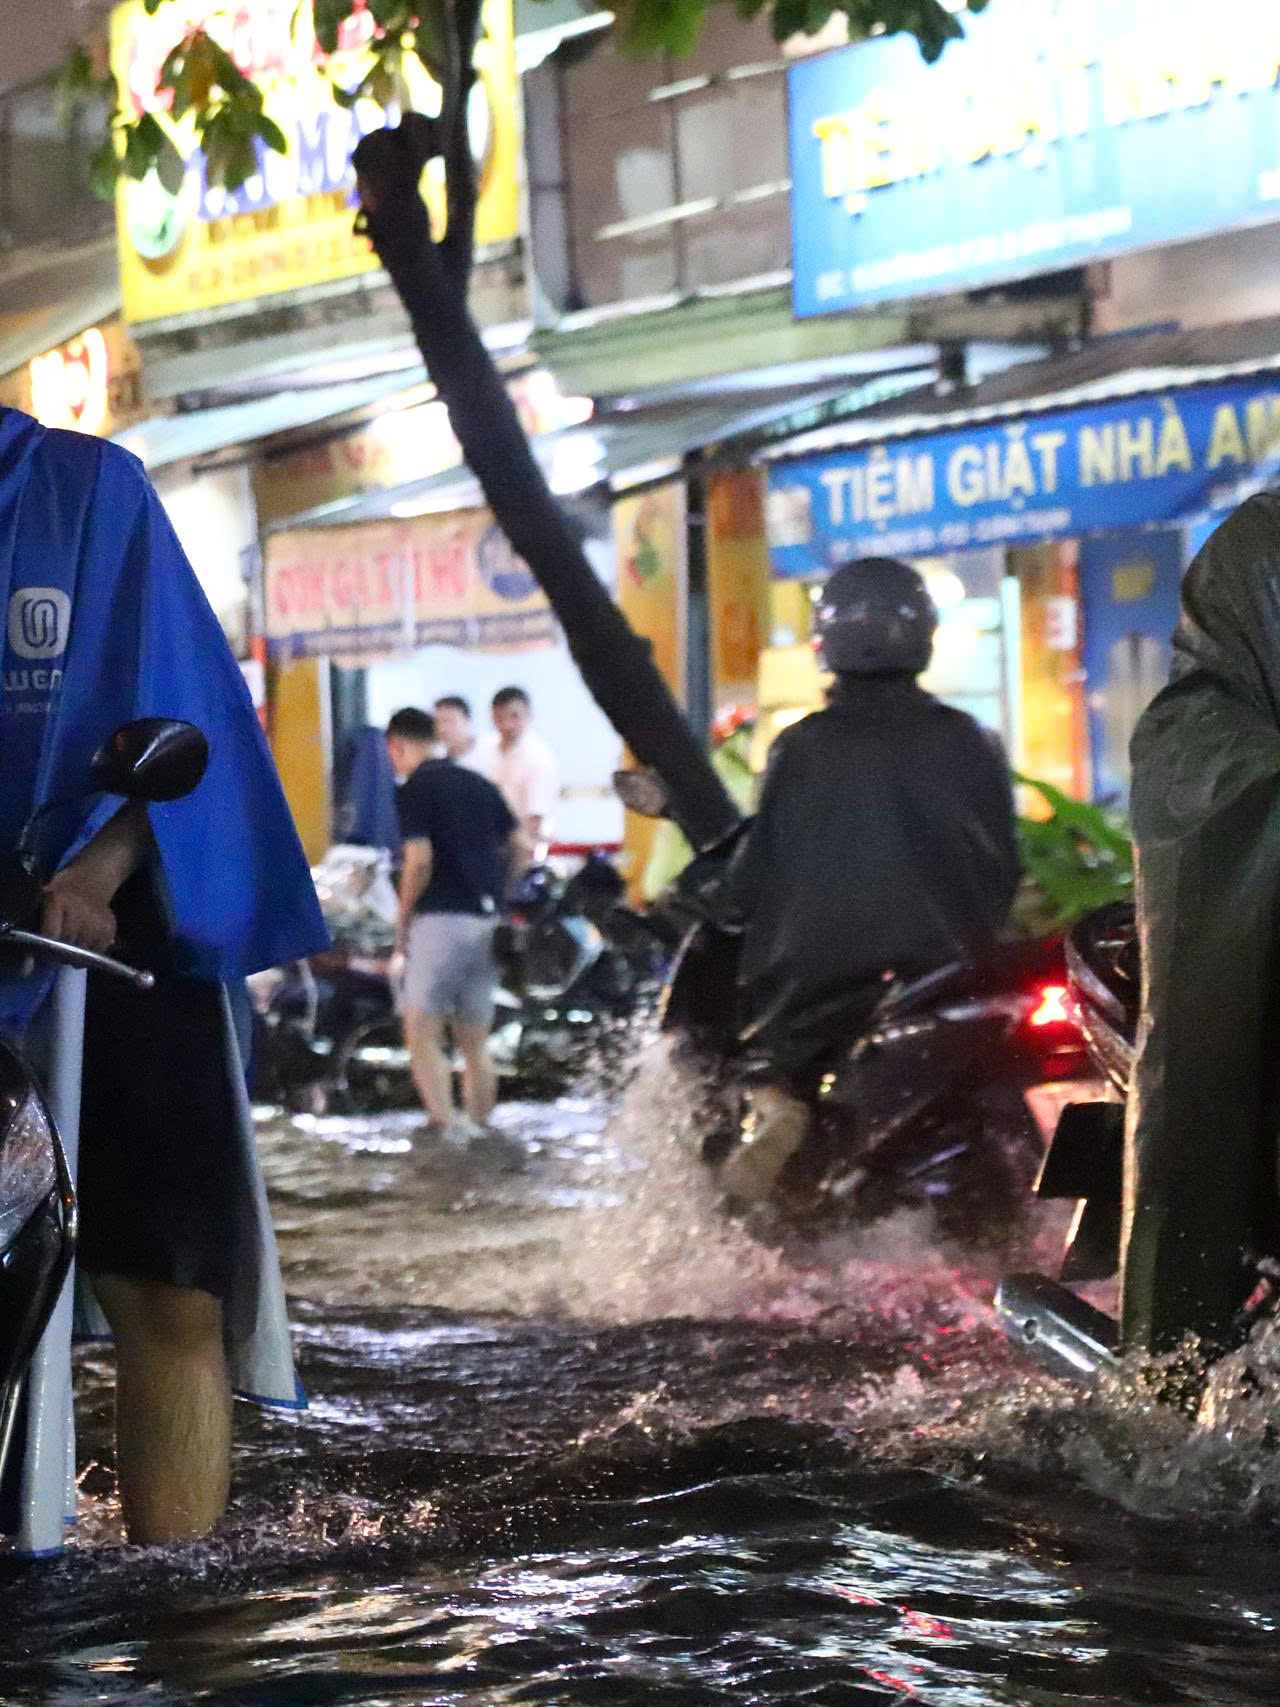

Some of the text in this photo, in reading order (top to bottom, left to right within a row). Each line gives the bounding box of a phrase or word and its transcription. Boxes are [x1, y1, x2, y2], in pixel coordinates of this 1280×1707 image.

[821, 445, 935, 533] TIỆM
[947, 422, 1066, 512] GIẶT
[1079, 395, 1193, 487] NHÀ
